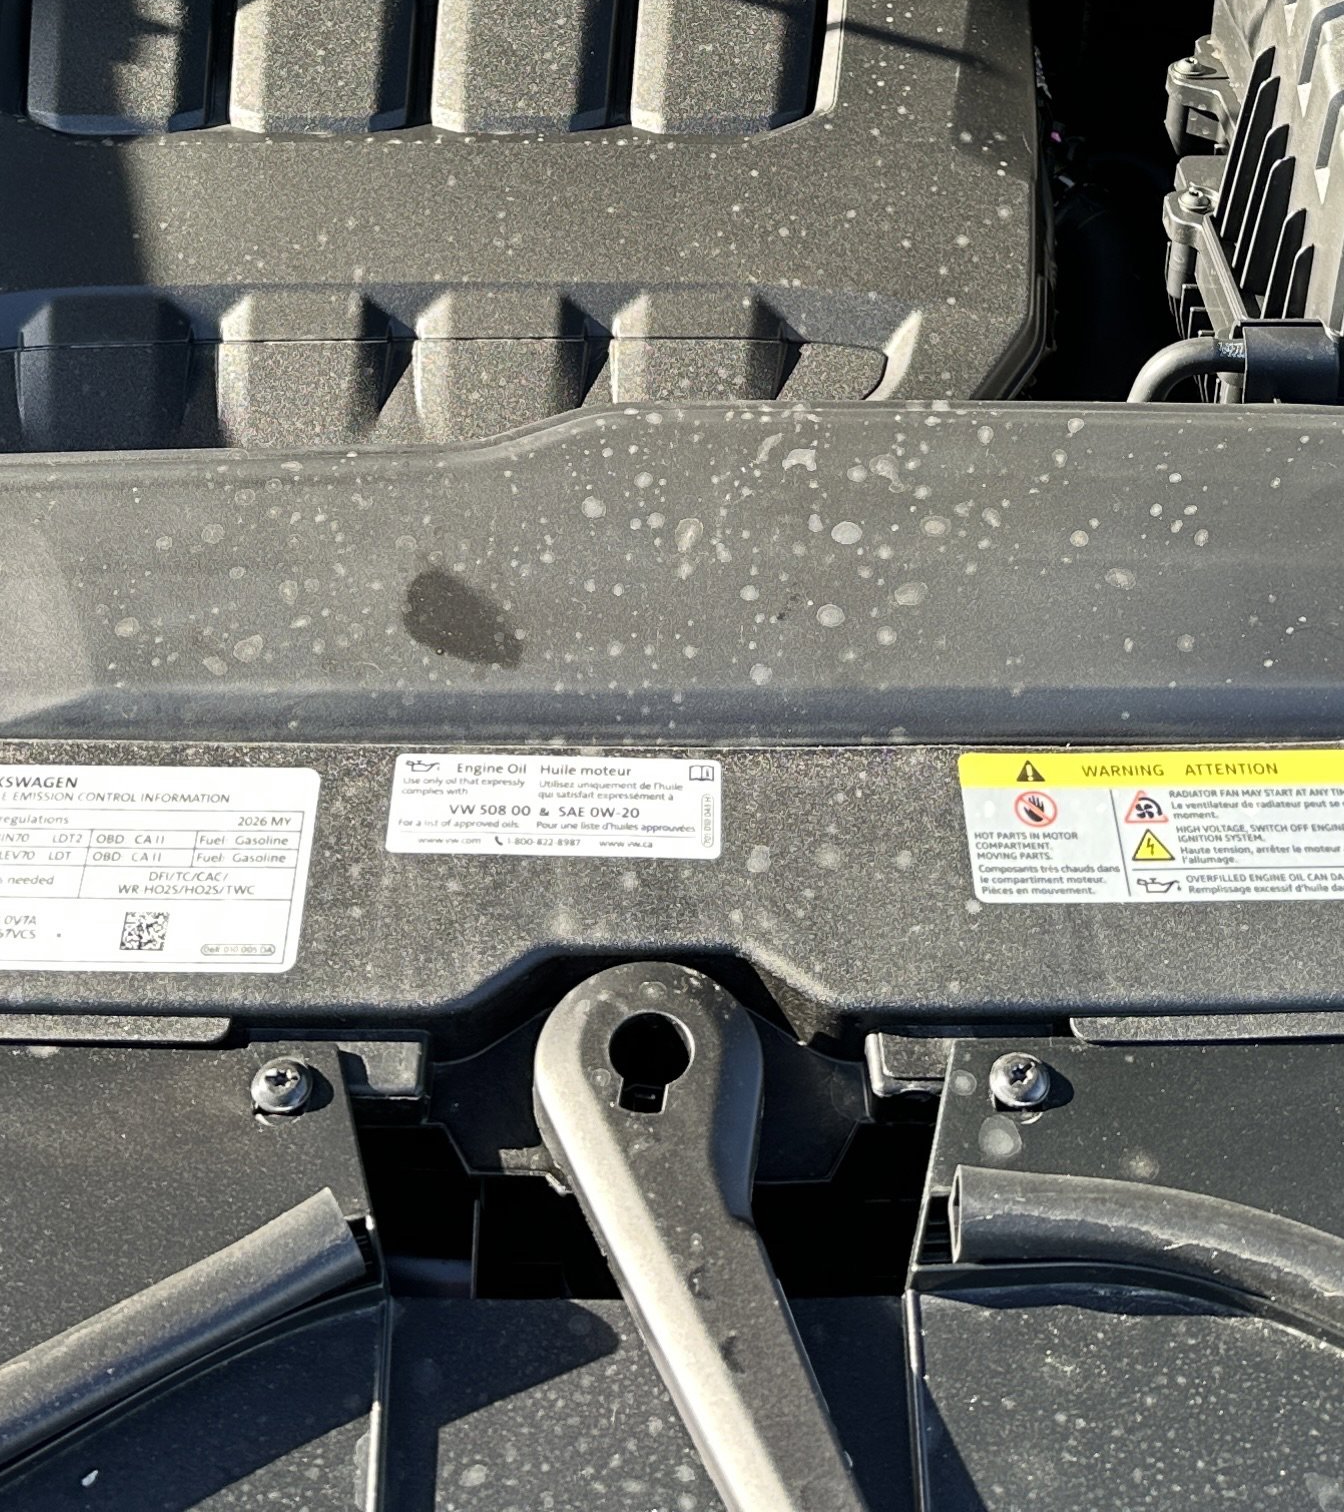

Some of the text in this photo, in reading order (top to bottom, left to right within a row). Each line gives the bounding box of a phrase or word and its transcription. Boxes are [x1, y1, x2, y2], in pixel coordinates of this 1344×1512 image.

[457, 763, 527, 776] Engine Oil
[540, 765, 631, 777] Huile moteur
[1082, 763, 1278, 777] WARNING ATTENTION
[423, 778, 443, 787] only
[482, 778, 525, 787] expressly
[577, 781, 638, 791] uniquement
[639, 782, 652, 790] de
[13, 791, 74, 802] EMISSION
[77, 792, 136, 802] CONTROL
[140, 792, 230, 803] INFORMATION
[401, 788, 444, 796] complies
[538, 791, 554, 800] qui
[556, 791, 594, 800] satisfait
[1169, 790, 1218, 798] RADIATOR
[1219, 790, 1240, 798] FAN
[1241, 789, 1262, 797] MAY
[1263, 789, 1293, 797] START
[1295, 789, 1307, 797] AT
[1309, 788, 1329, 796] ANY
[1171, 801, 1183, 810] Le
[1185, 801, 1239, 809] ventilateur
[1241, 800, 1254, 809] de
[1256, 800, 1302, 808] radiateur
[1304, 799, 1327, 809] peut
[449, 805, 640, 818] VW 508 00 & SAE 0W-20
[0, 814, 69, 826] regulations
[238, 816, 292, 826] 2026 MY
[398, 819, 413, 827] For
[441, 819, 451, 827] of
[454, 820, 500, 829] approved
[536, 821, 557, 830] Pour
[580, 822, 600, 830] liste
[641, 823, 696, 834] approuvées
[1176, 825, 1201, 834] HIGH
[1249, 824, 1288, 833] SWITCH
[1290, 824, 1309, 832] OFF
[52, 834, 83, 843] LDT2
[95, 834, 125, 844] OBD
[134, 834, 152, 844] CA
[234, 835, 289, 846] Gasoline
[974, 832, 1079, 840] HOT PARTS IN MOTOR
[1178, 834, 1223, 843] IGNITION
[1180, 846, 1211, 855] Haute
[1292, 844, 1302, 853] le
[1304, 844, 1341, 853] moteur
[48, 851, 72, 860] LDT
[92, 851, 122, 861] OBD
[131, 851, 149, 861] CA
[232, 853, 286, 863] Gasoline
[977, 851, 1054, 860] MOVING PARTS.
[978, 864, 1039, 875] Composants
[1060, 864, 1095, 874] chauds
[1097, 864, 1121, 873] dans
[8, 875, 55, 885] needed
[980, 876, 989, 884] le
[991, 875, 1065, 885] compartiment
[1186, 874, 1247, 883] OVERFILLED
[1249, 874, 1286, 883] ENGINE
[1288, 873, 1305, 882] OIL
[1307, 873, 1329, 882] CAN
[1016, 887, 1029, 895] en
[1188, 885, 1251, 895] Remplissage
[1253, 884, 1293, 893] excessif
